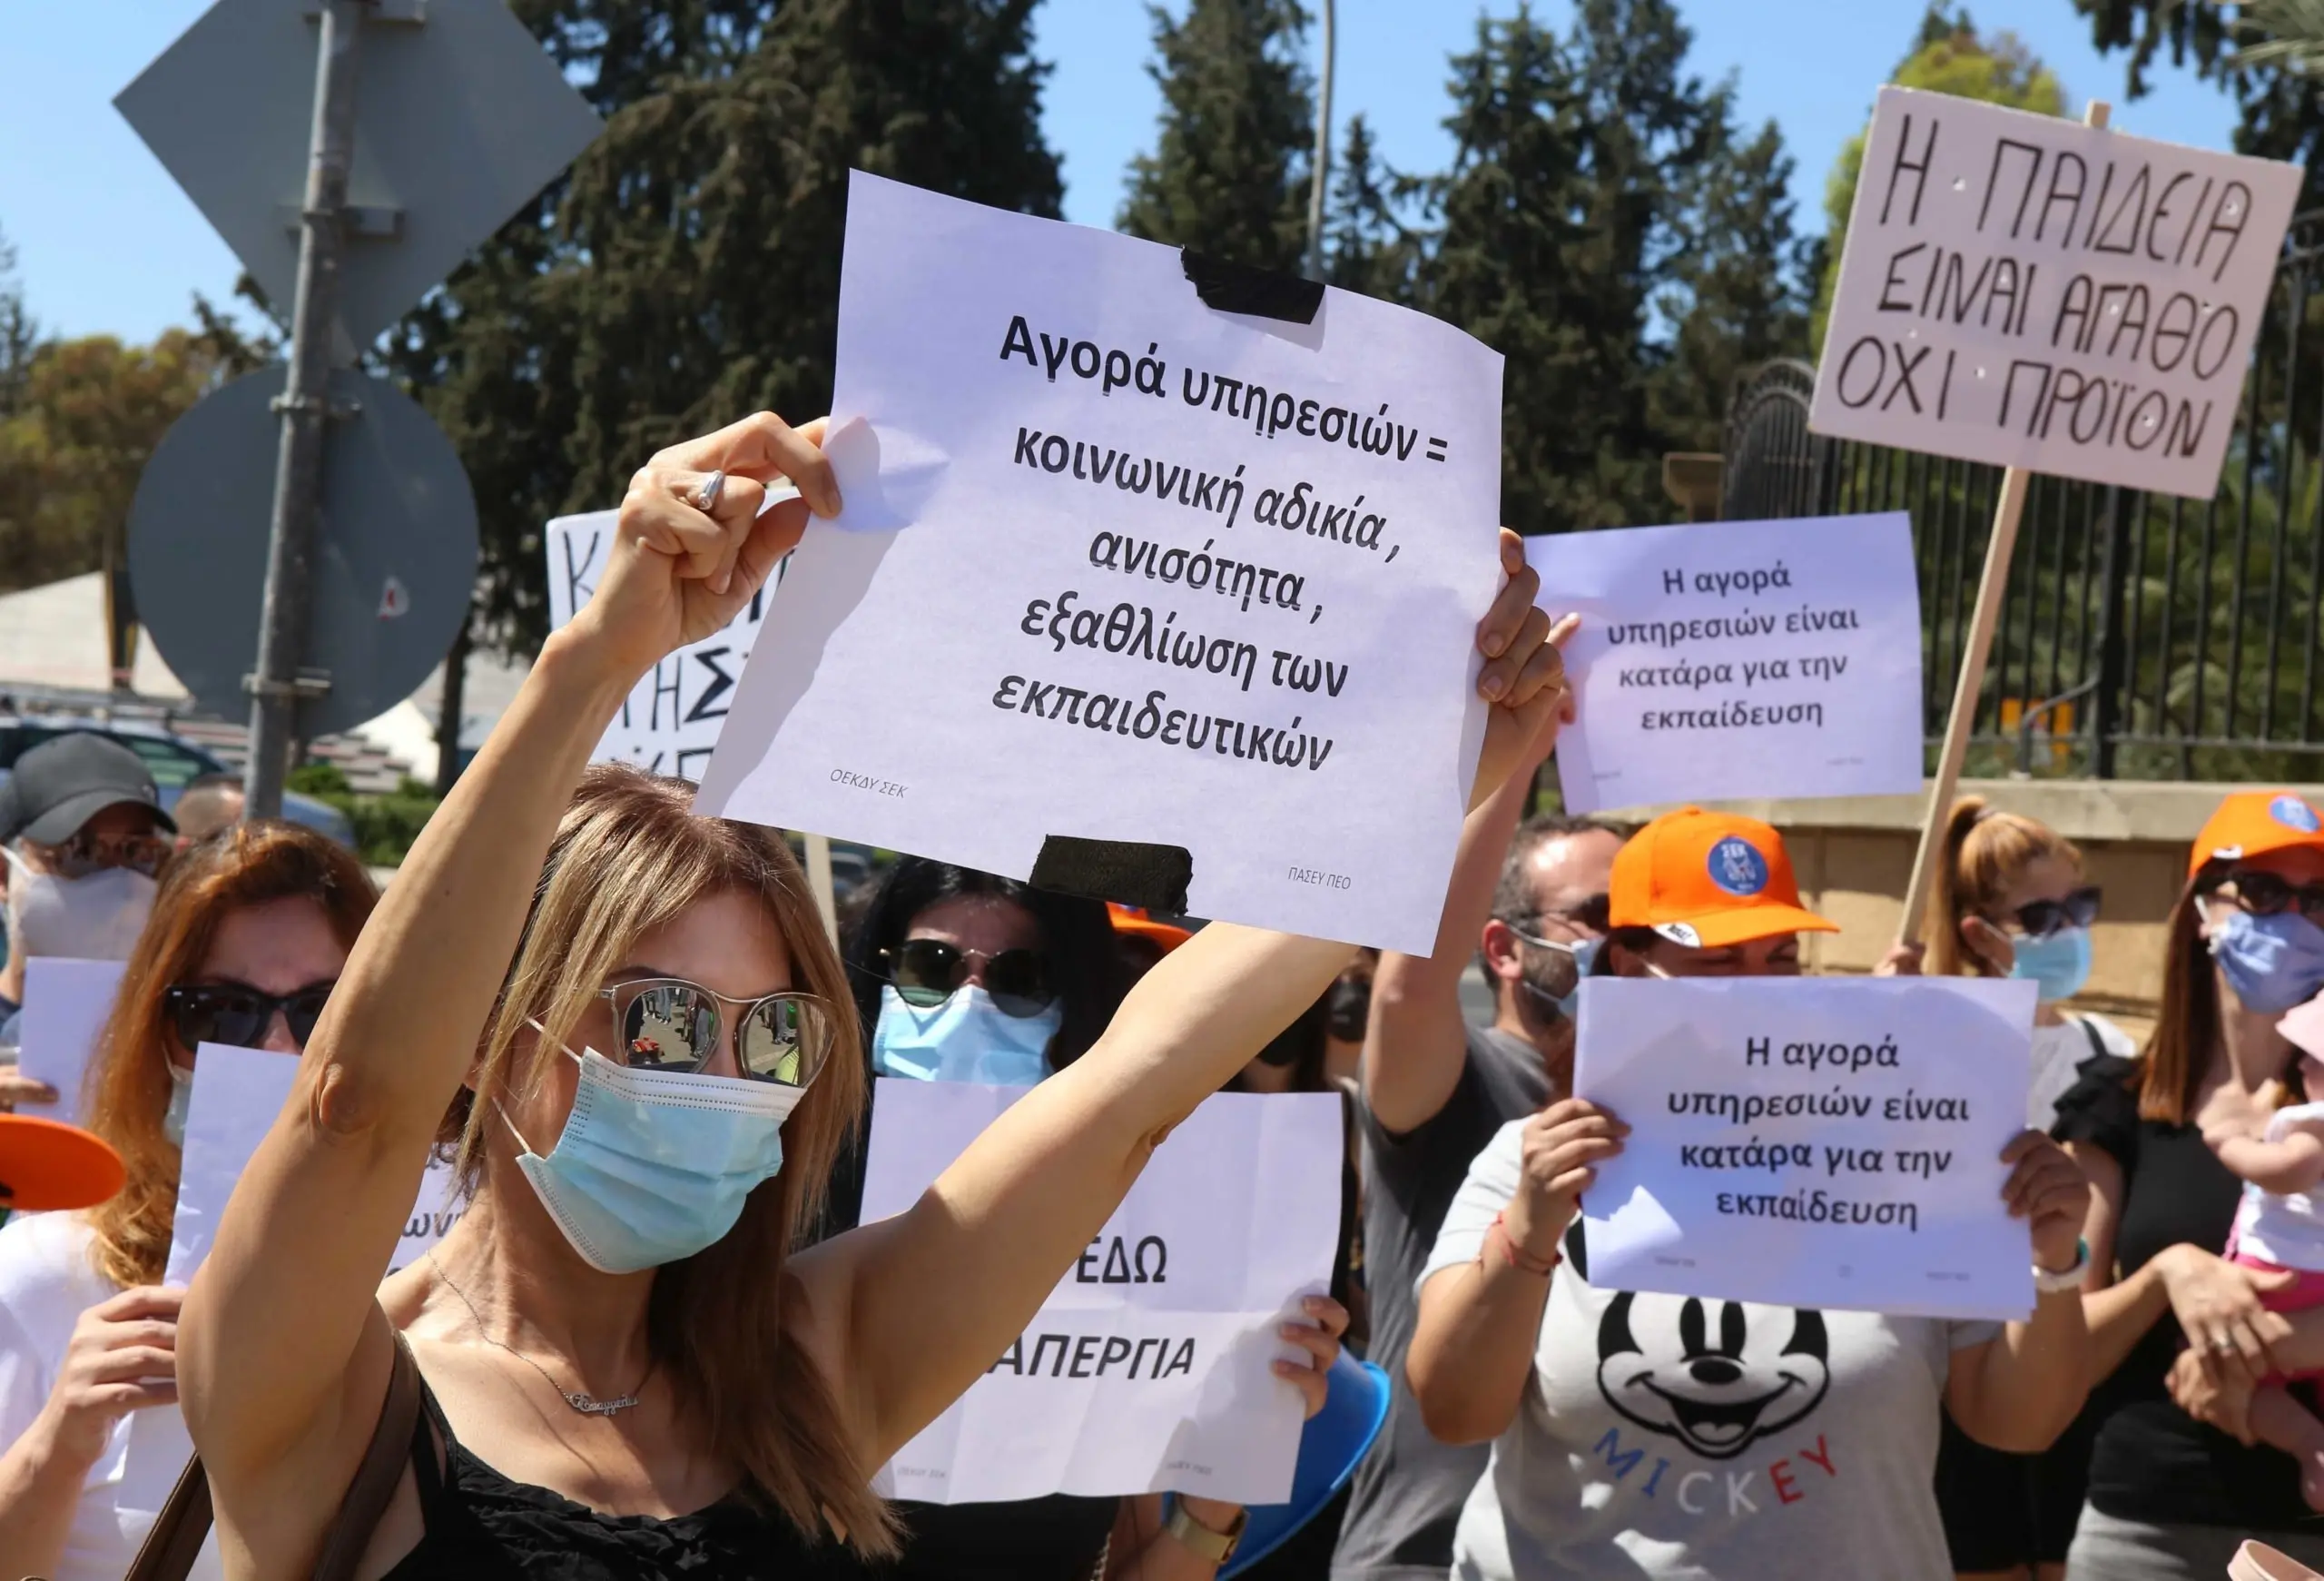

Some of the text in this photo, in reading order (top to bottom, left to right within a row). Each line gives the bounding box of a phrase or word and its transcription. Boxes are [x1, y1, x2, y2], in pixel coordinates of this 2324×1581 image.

[1879, 114, 2253, 284] Η ΠΑΙΔΕΙΑ
[2052, 272, 2240, 381] ΑΓΑΘΟ
[1000, 315, 1167, 398] Αγορά
[1183, 367, 1418, 461] υπηρεσιών
[1837, 335, 1956, 420] ΟΧΙ
[1014, 427, 1246, 529] κοινωνική
[1663, 560, 1792, 598] Η αγορά
[1020, 589, 1349, 697] εξαθλίωση των
[1607, 605, 1860, 647] υπηρεσιών είναι
[1620, 655, 1848, 691] κατάρα για την
[992, 672, 1334, 771] εκπαιδευτικών
[1641, 701, 1824, 730] εκπαίδευση
[830, 768, 909, 798] ΟΕΚΔΥ ΣΕΚ
[1288, 866, 1352, 890] ΠΑΣΕΥ ΠΕΟ
[1746, 1033, 1900, 1073] Η αγορά
[1668, 1085, 1969, 1125] υπηρεσιών είναι
[1681, 1136, 1952, 1180] κατάρα για την
[1716, 1189, 1918, 1232] εκπαίδευση
[1076, 1235, 1167, 1284] ΕΔΩ
[986, 1333, 1196, 1380] ΑΠΕΡΓΙΑ
[1593, 1427, 1836, 1516] MICKEY
